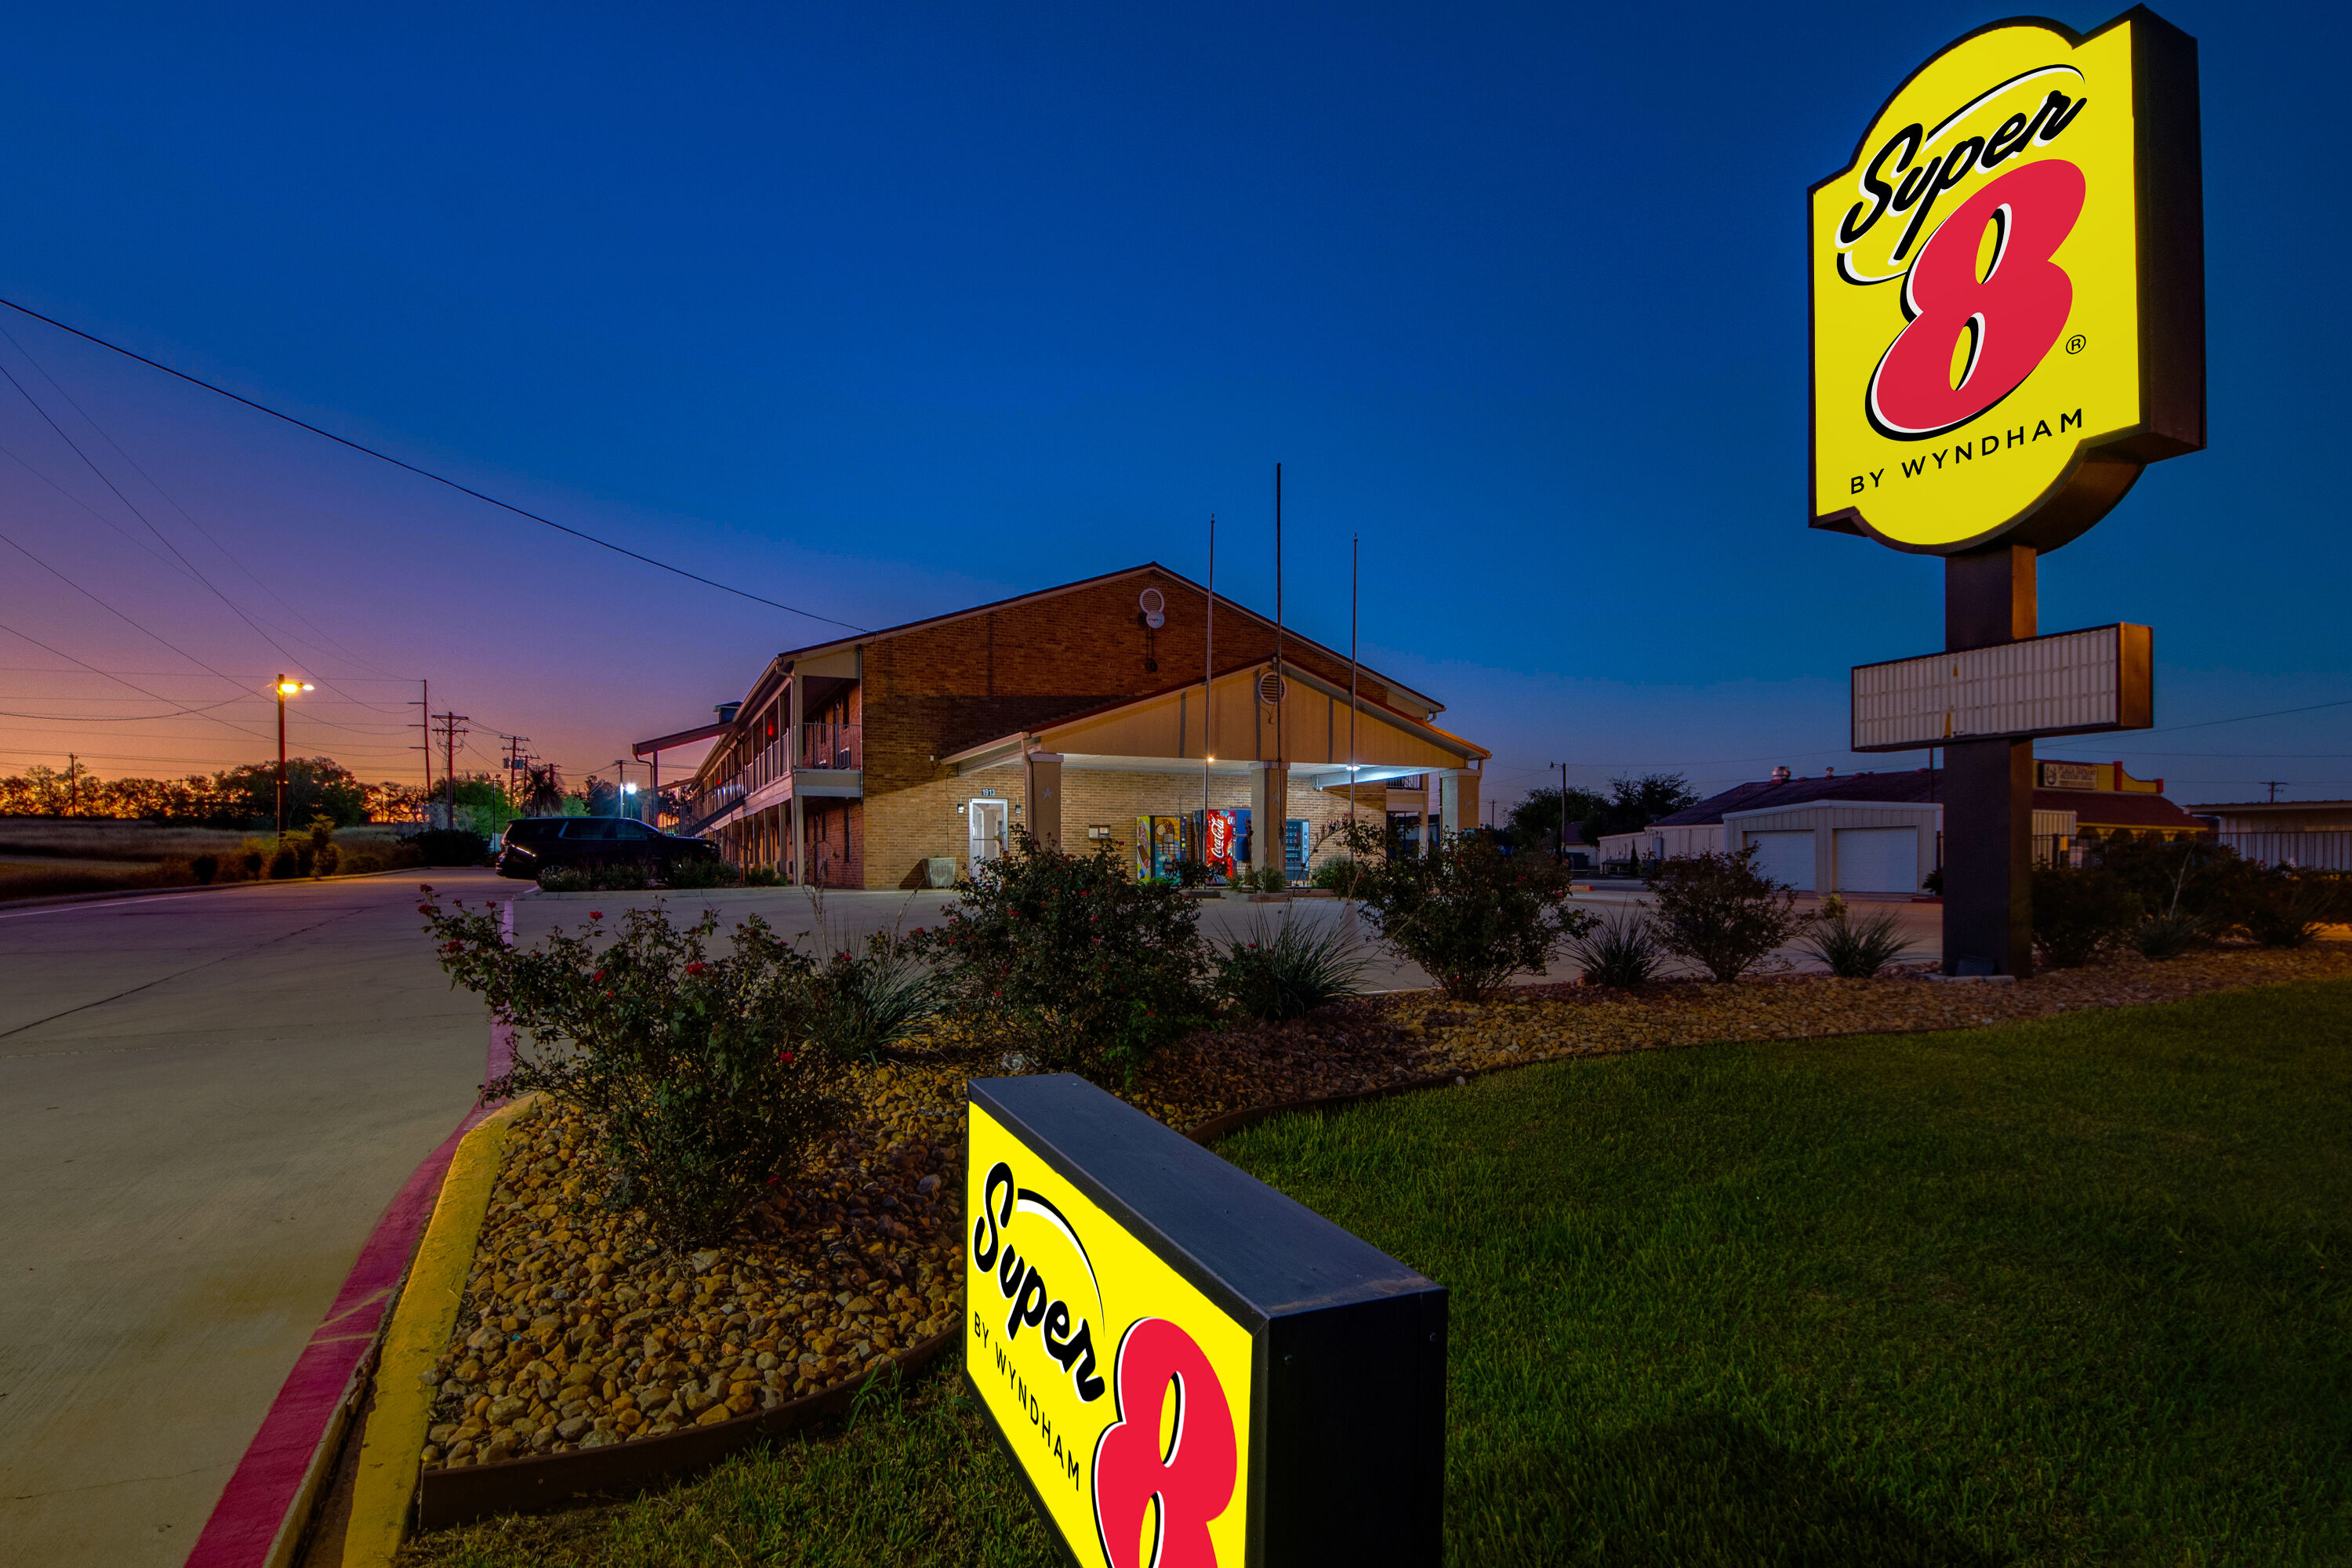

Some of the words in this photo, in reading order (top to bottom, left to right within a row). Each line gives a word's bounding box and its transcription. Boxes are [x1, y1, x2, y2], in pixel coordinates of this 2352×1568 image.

[1835, 89, 2088, 266] Super
[1865, 159, 2086, 441] 8
[1851, 469, 1884, 495] BY
[1901, 408, 2082, 478] WYNDHAM
[972, 1162, 1105, 1403] Super
[975, 1311, 989, 1348] BY
[995, 1341, 1080, 1491] WYNDHAM
[1091, 1317, 1237, 1568] 8
